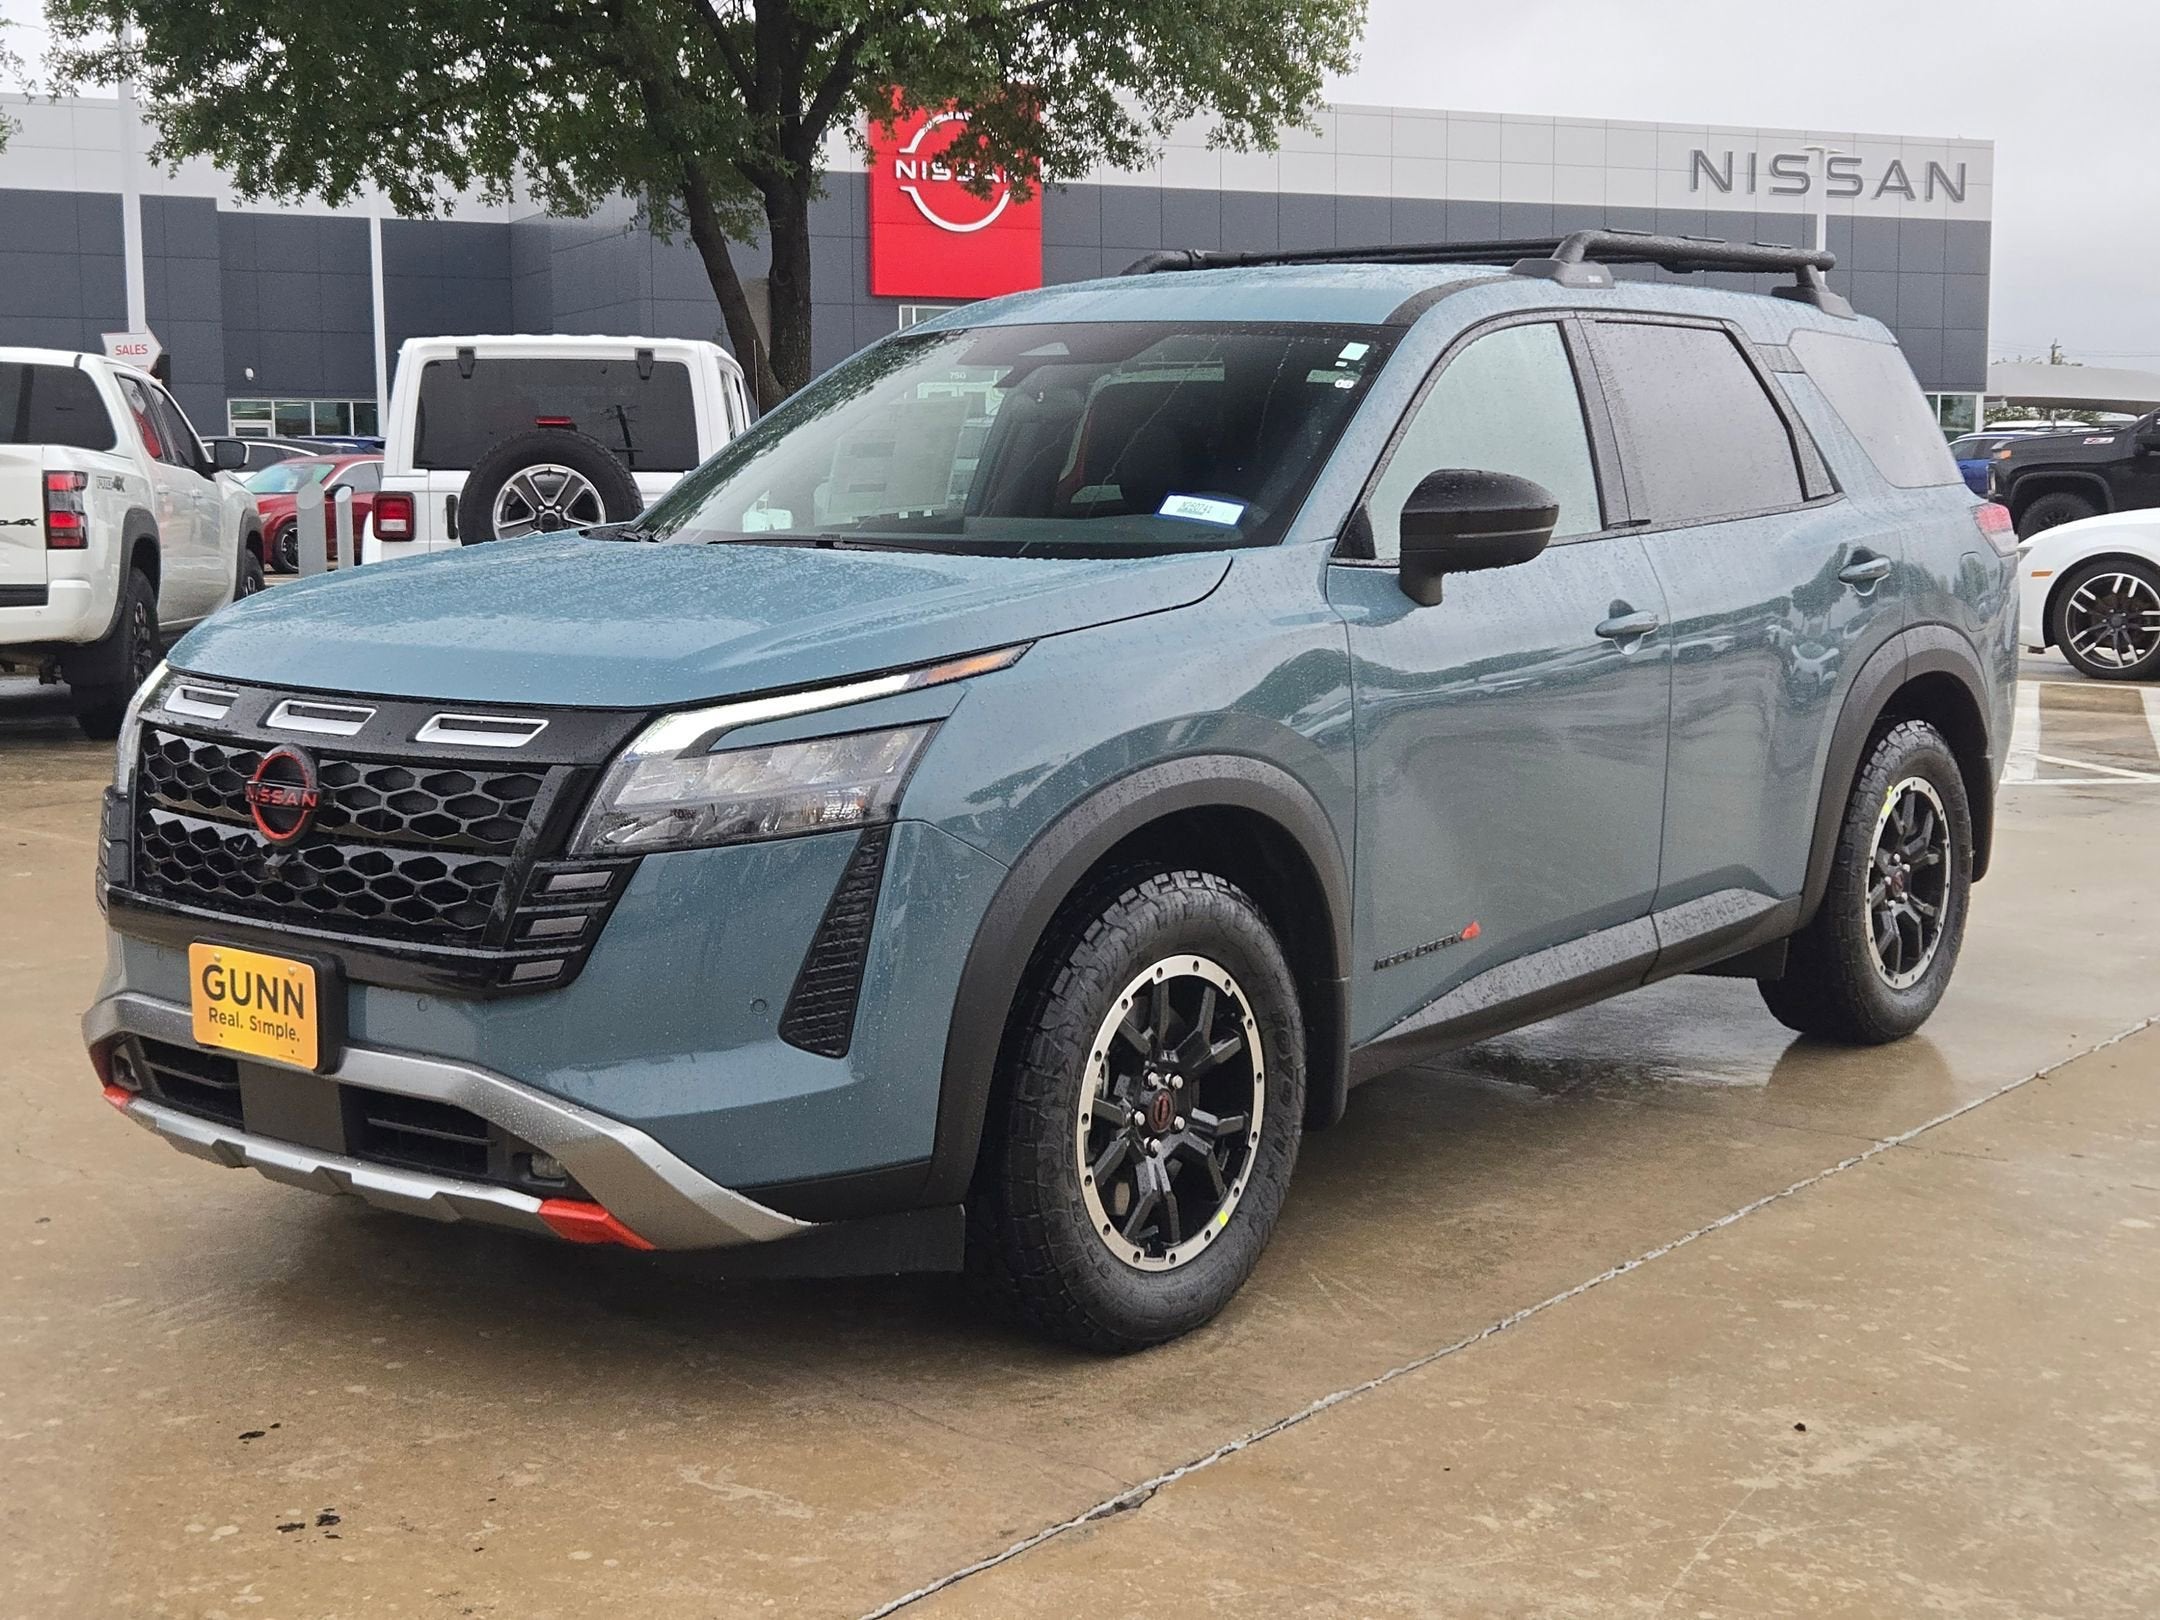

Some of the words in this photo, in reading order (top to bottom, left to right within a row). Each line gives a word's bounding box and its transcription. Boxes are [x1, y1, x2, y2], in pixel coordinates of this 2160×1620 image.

[1690, 149, 1967, 203] NISSAN
[115, 344, 148, 355] SALES
[245, 783, 318, 808] NISSAN
[202, 963, 304, 1020] GUNN
[208, 1007, 244, 1029] Real.
